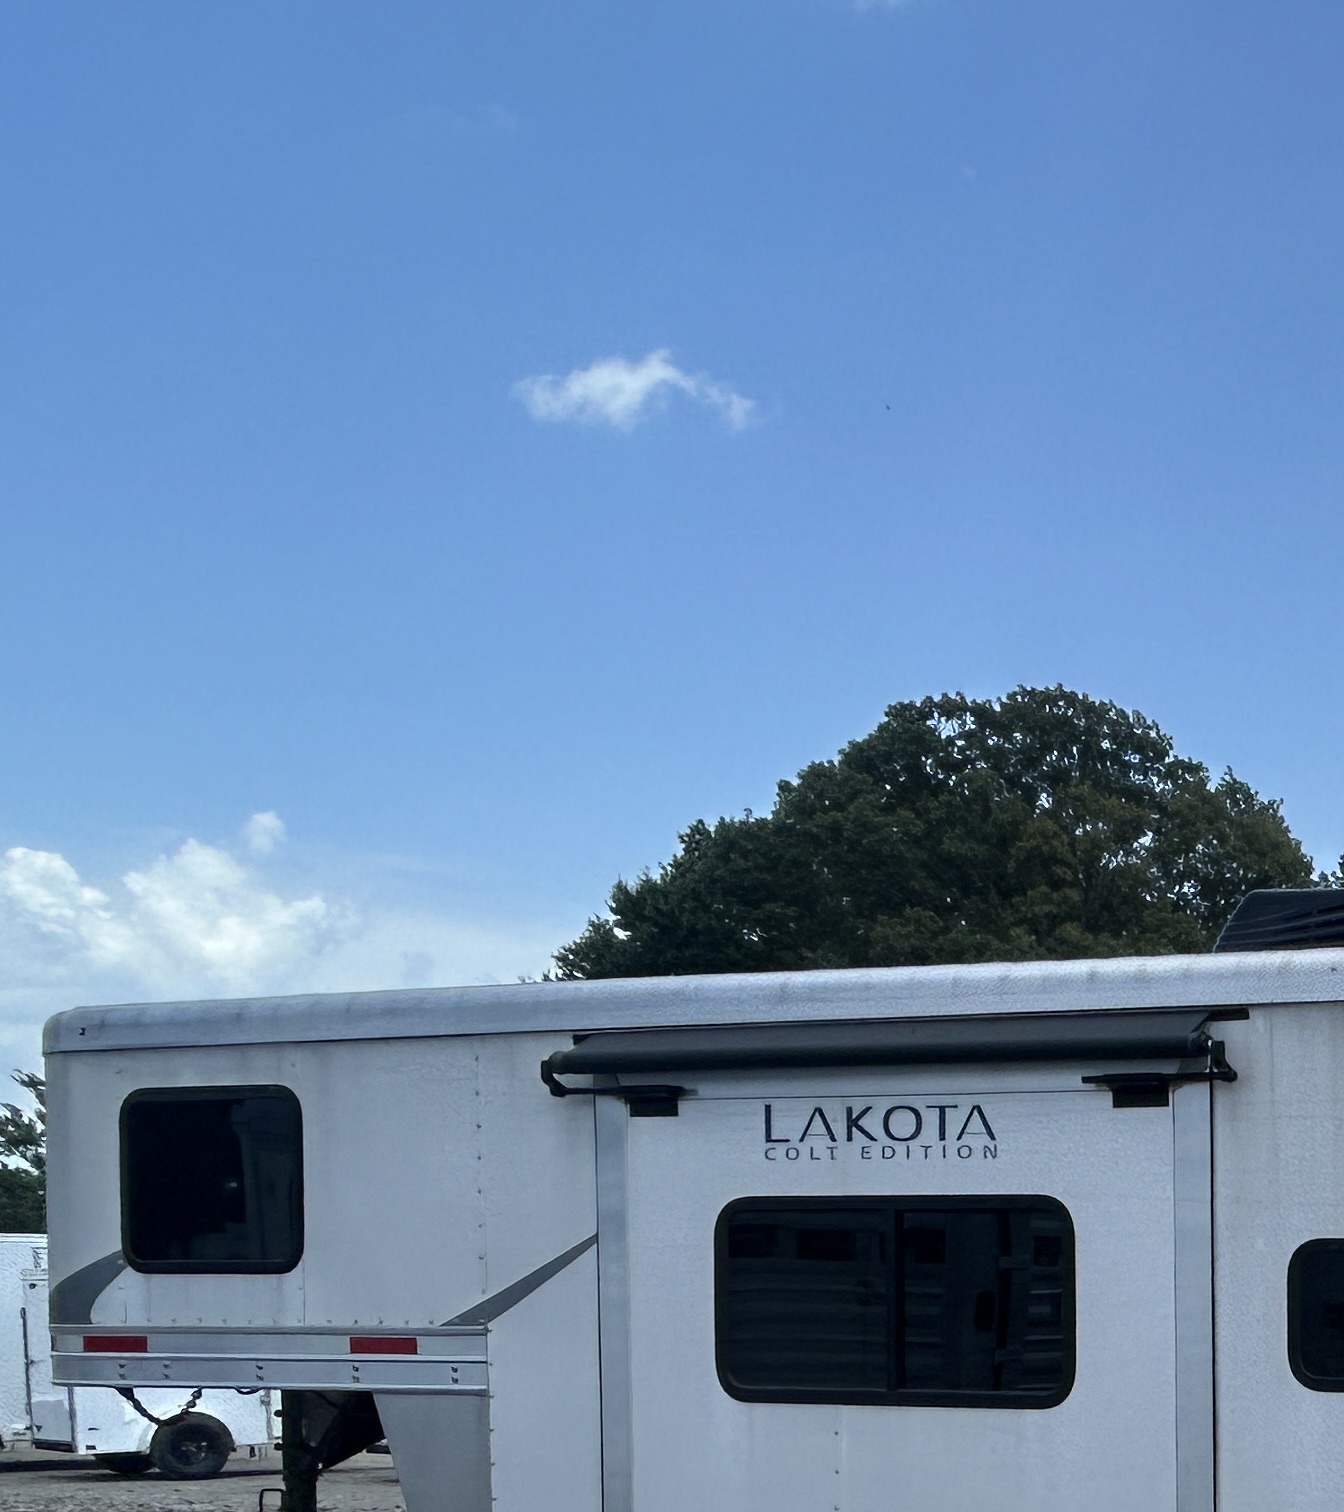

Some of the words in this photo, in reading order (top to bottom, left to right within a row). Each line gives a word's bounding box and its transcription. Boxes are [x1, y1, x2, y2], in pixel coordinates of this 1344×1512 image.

[764, 1104, 997, 1143] LAKOTA
[764, 1146, 838, 1161] COLT
[860, 1144, 998, 1161] EDITION
